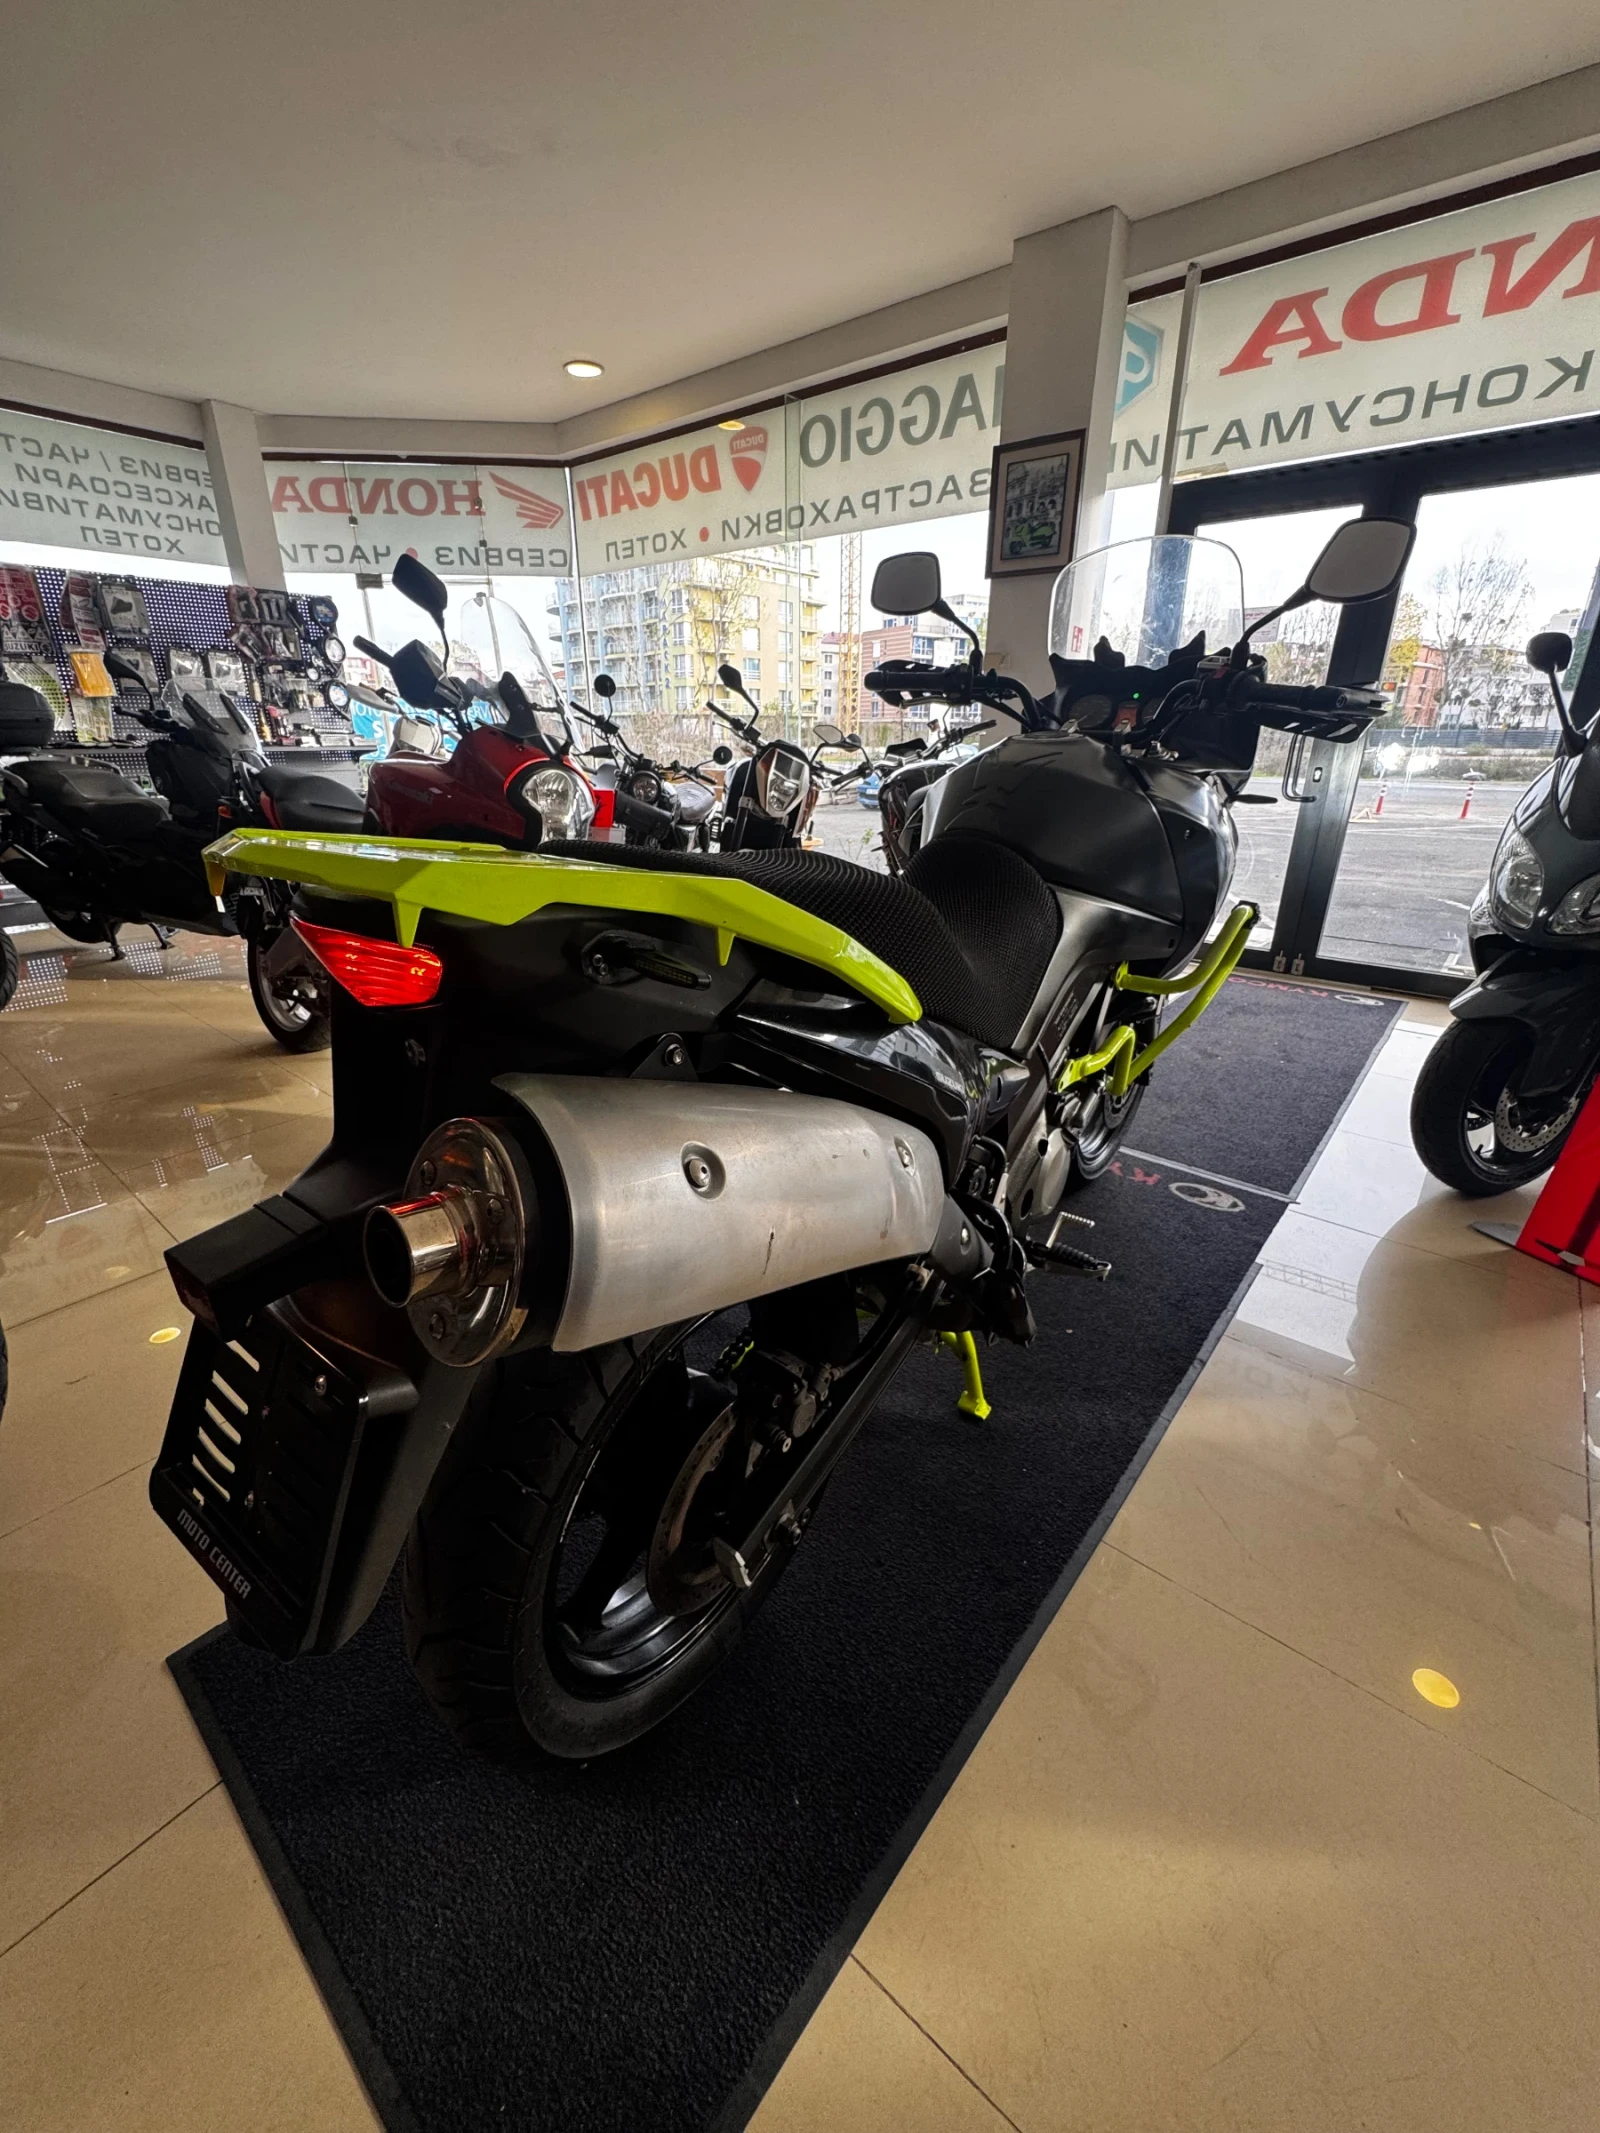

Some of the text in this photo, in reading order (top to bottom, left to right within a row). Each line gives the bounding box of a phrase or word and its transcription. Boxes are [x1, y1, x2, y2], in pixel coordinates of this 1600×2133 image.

[4, 642, 39, 652] SUZUKI
[1228, 976, 1328, 998] KYMCO
[177, 1508, 252, 1599] MOTO CENTER
